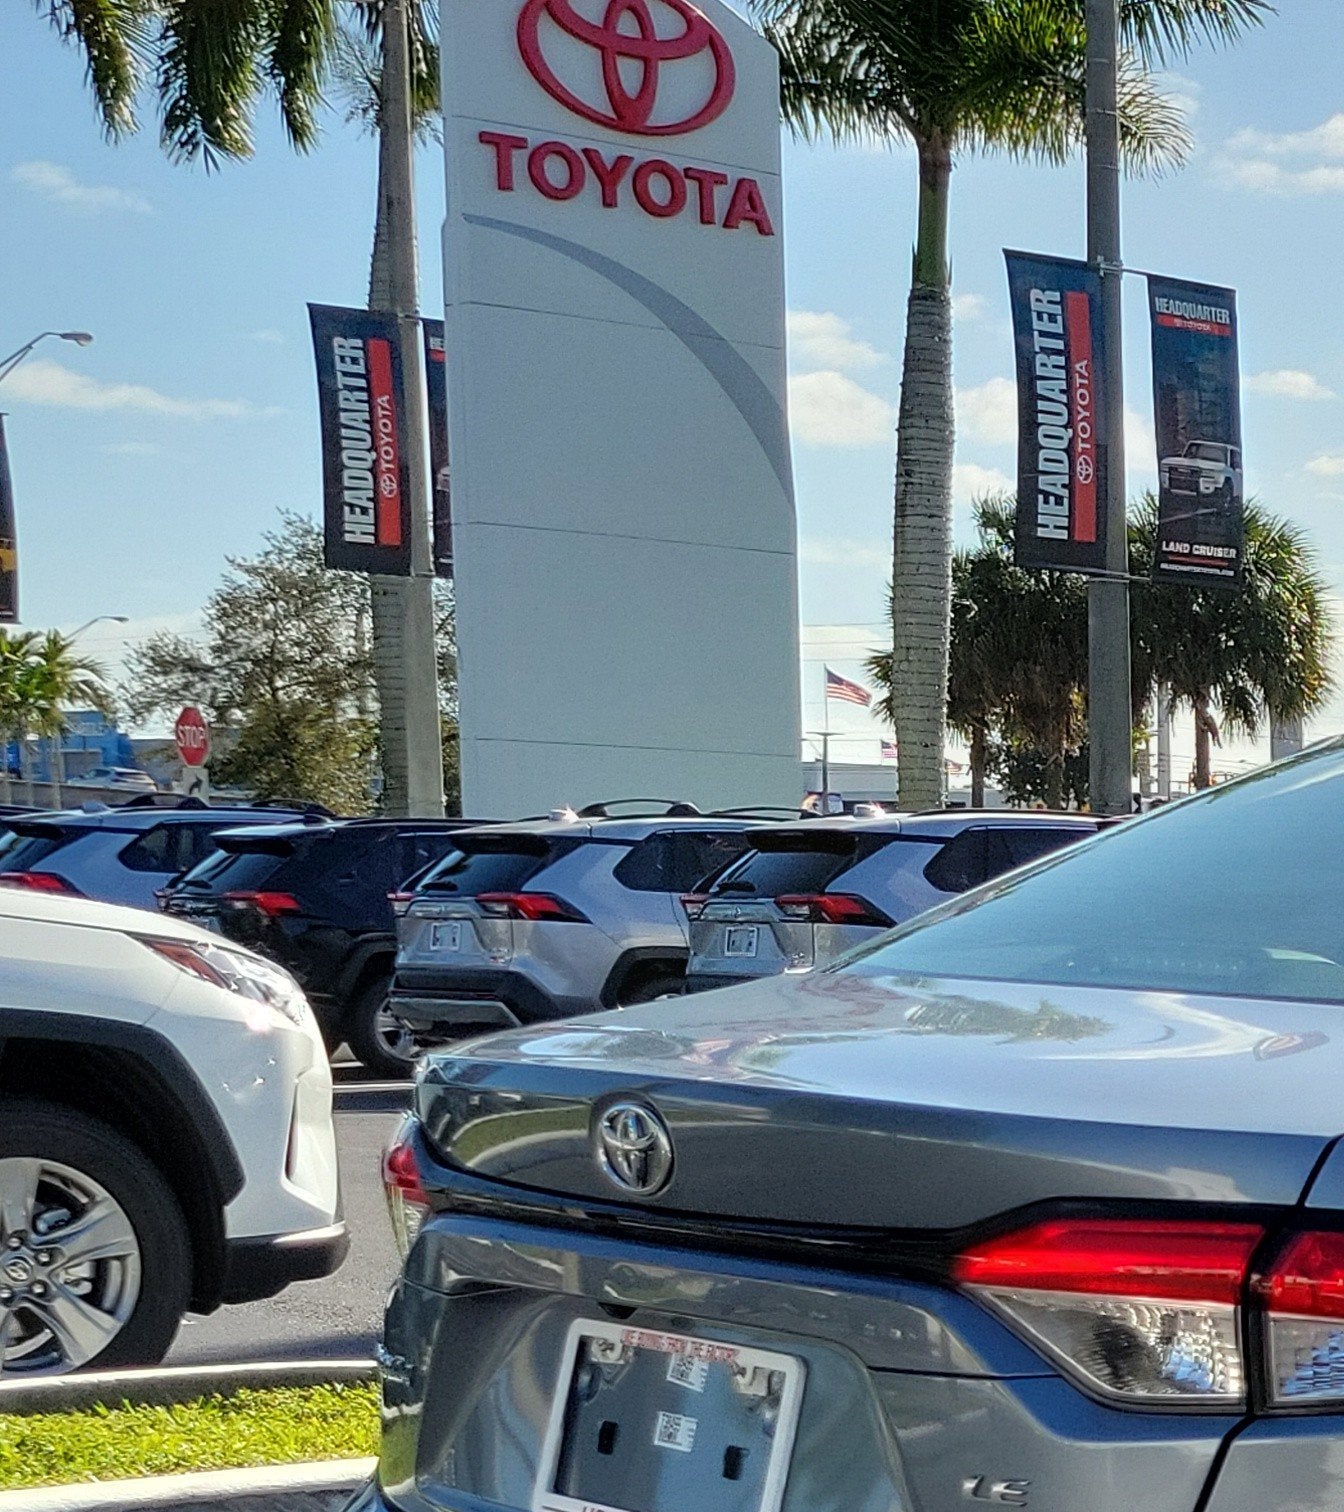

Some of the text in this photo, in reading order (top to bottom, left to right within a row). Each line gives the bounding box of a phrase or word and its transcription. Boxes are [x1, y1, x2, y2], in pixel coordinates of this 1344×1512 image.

[478, 131, 775, 236] TOYOTA
[1155, 297, 1230, 324] HEADQUARTER
[333, 336, 376, 544] HEADQUARTER
[377, 395, 396, 471] TOYOTA
[1030, 288, 1073, 540] HEADQUARTER
[1074, 360, 1092, 452] TOYOTA
[1162, 540, 1236, 558] LAND CRUISER
[177, 726, 204, 748] STOP
[963, 1474, 1031, 1507] LE
